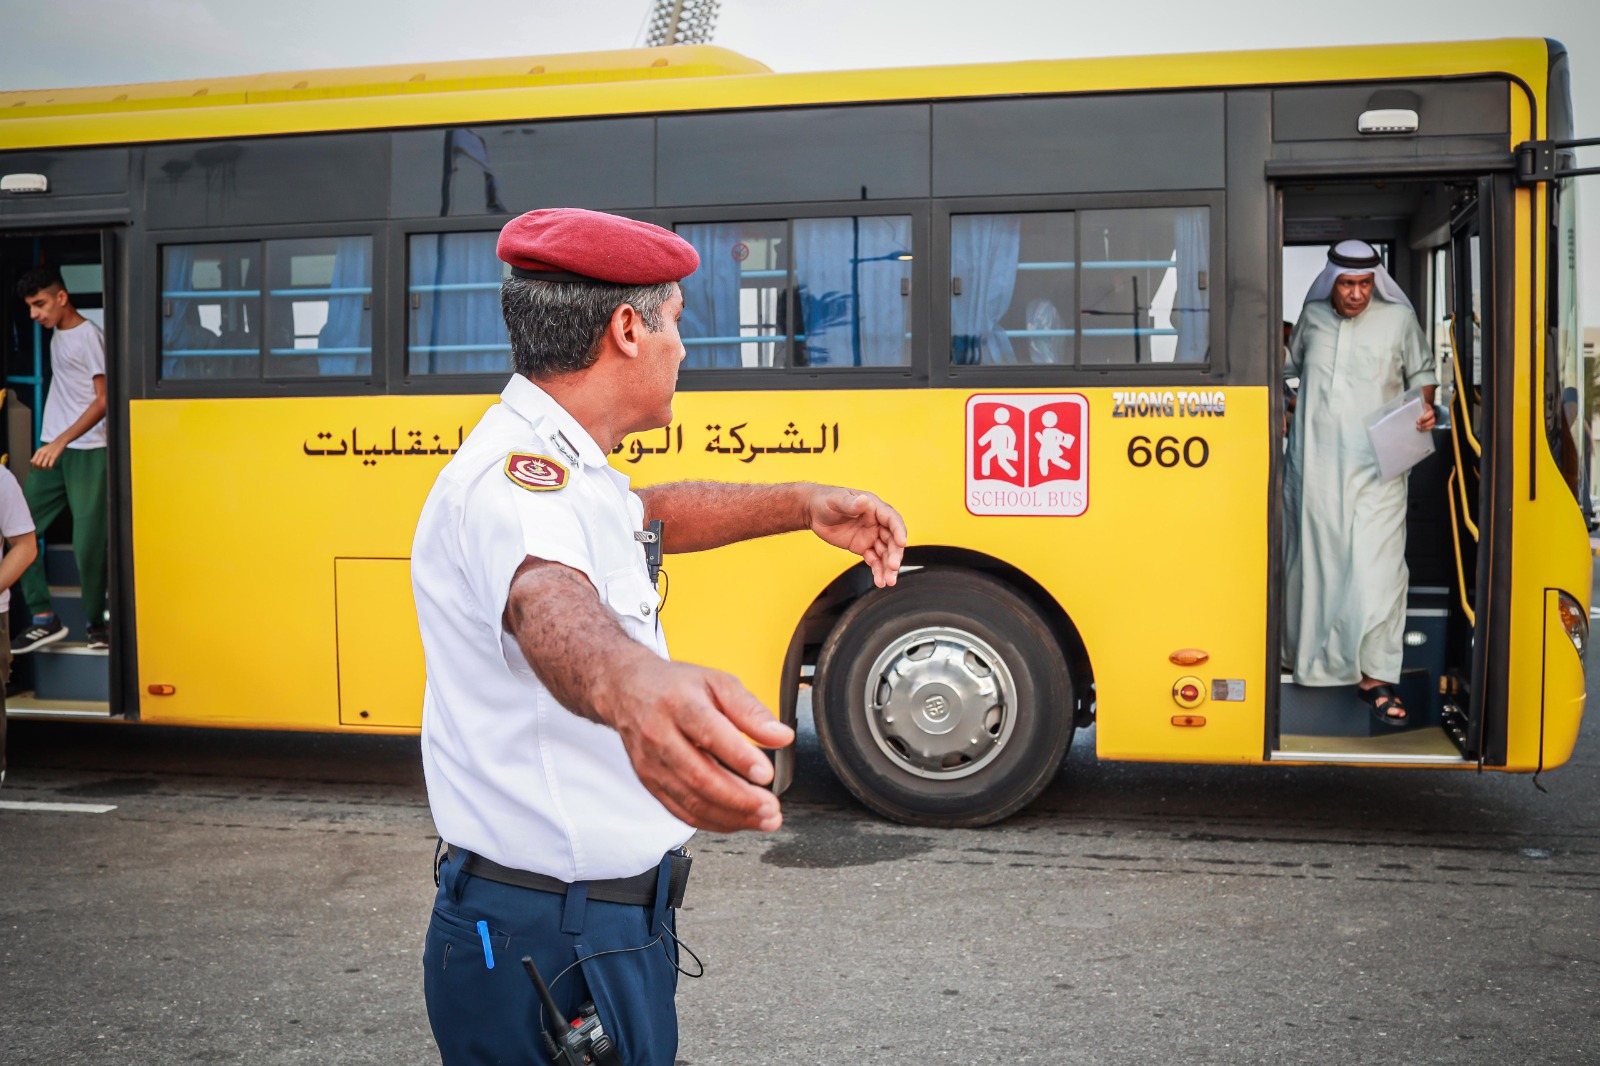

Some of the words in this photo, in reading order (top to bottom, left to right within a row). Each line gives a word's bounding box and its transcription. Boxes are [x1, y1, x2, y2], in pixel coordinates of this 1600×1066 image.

[1112, 391, 1174, 417] ZHONG
[1177, 391, 1225, 416] TONG
[303, 426, 463, 467] لنقليات
[705, 423, 838, 463] الشركة
[1127, 436, 1210, 467] 660
[971, 490, 1042, 507] SCHOOL
[1048, 490, 1083, 507] BUS
